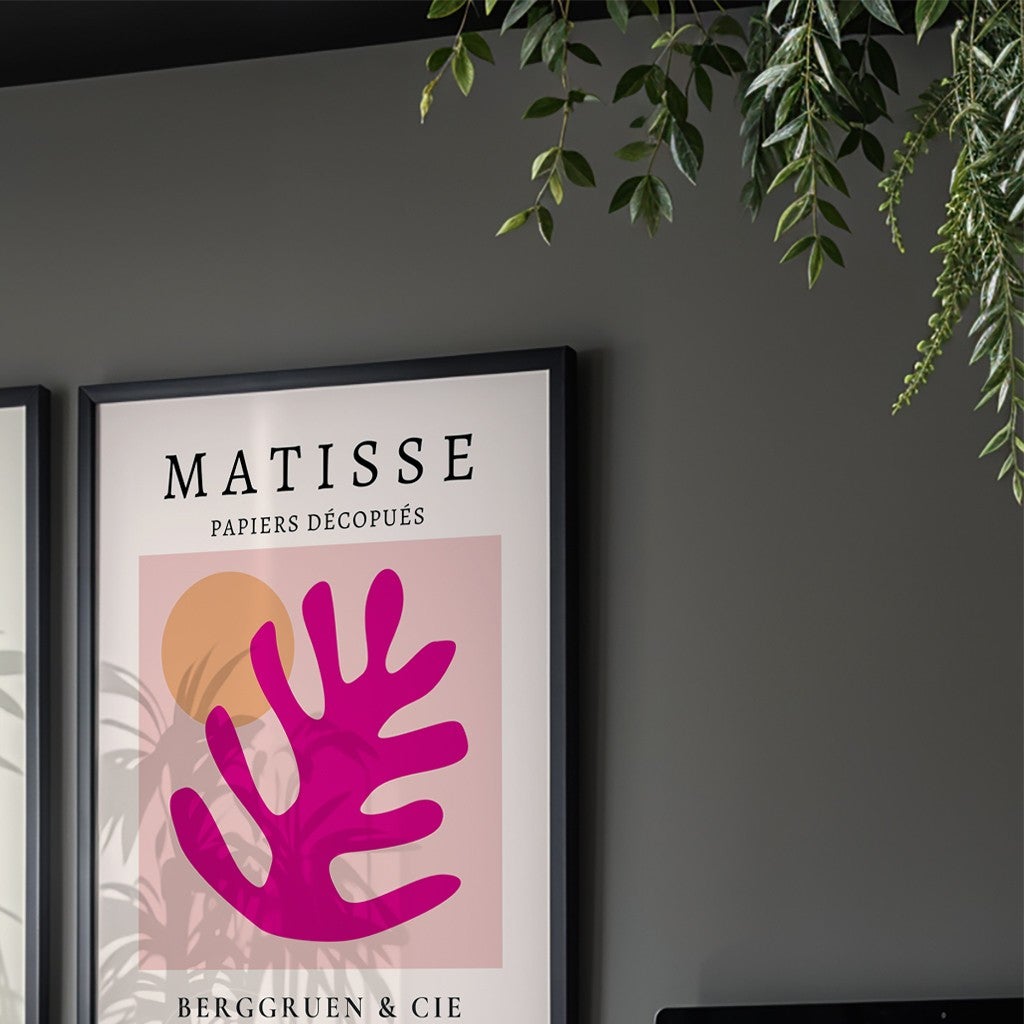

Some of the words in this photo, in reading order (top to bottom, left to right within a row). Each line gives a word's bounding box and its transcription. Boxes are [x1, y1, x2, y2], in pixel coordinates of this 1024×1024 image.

[163, 433, 474, 500] MATISSE
[210, 513, 299, 537] PAPIERS
[307, 503, 425, 532] DÉCOPUÉS
[177, 996, 364, 1019] BERGGRUEN
[378, 996, 398, 1019] &
[410, 996, 462, 1019] CIE
